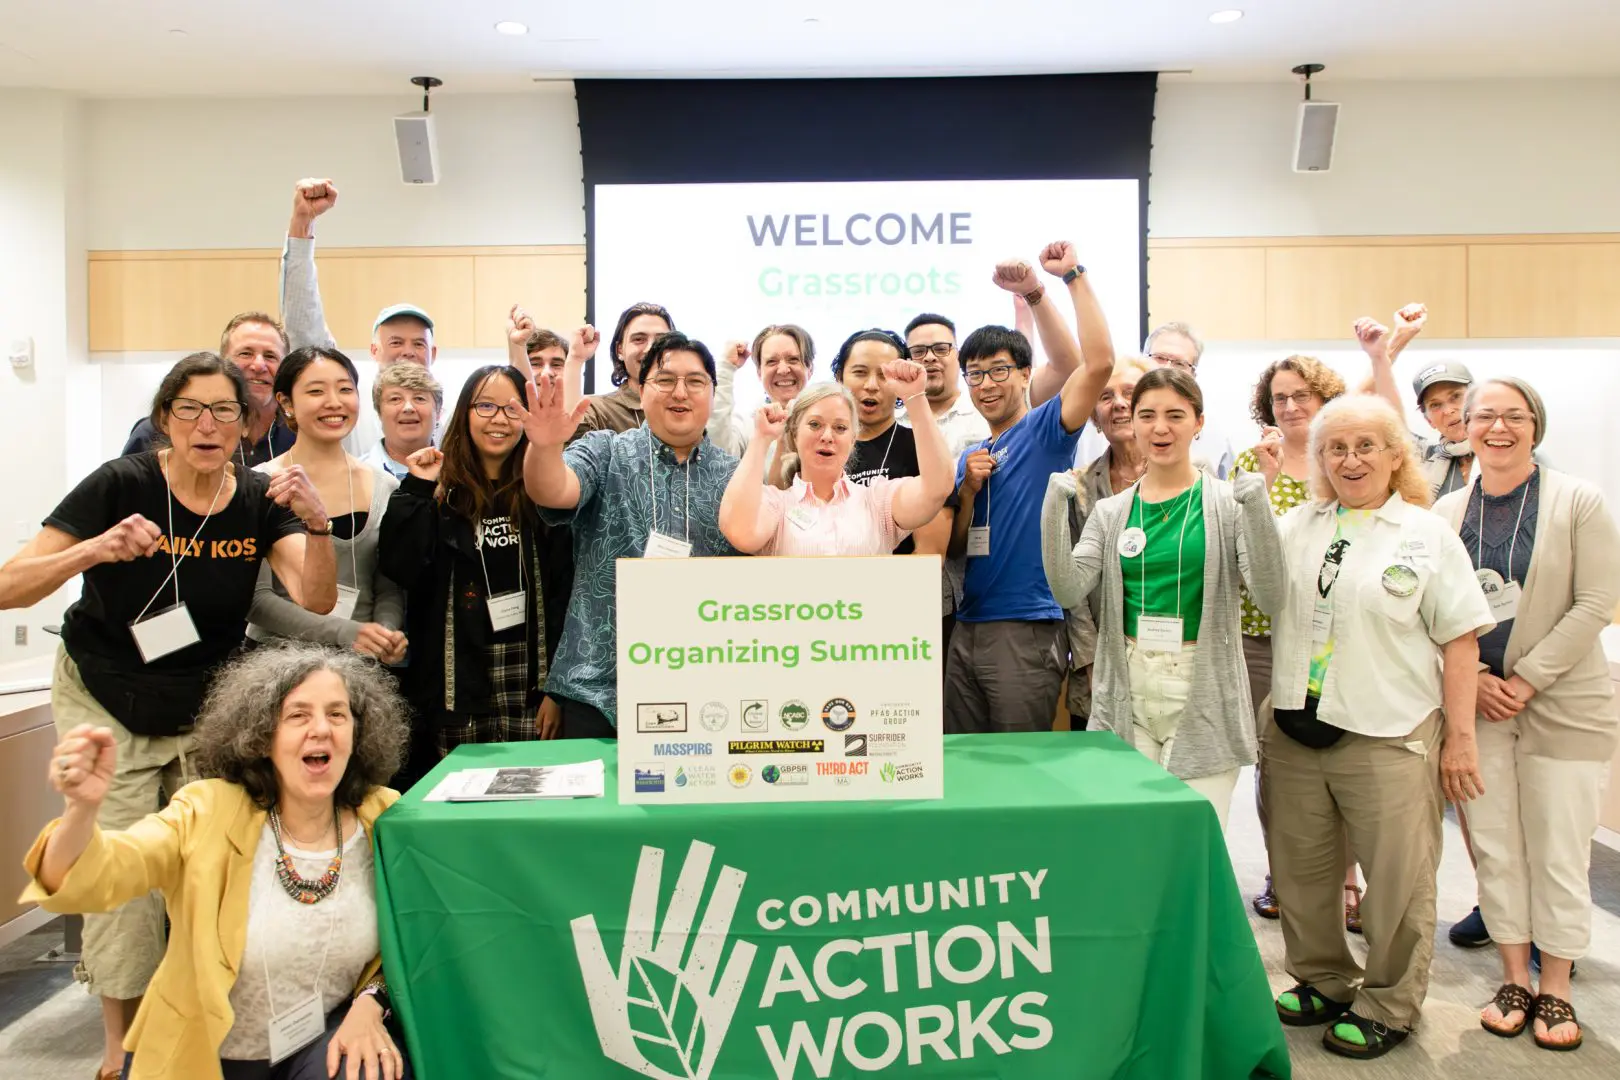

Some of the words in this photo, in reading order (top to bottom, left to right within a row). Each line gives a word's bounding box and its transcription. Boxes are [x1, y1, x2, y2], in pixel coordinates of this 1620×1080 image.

[746, 212, 973, 247] WELCOME
[758, 264, 962, 297] Grassroots
[482, 516, 511, 525] COMMU
[159, 535, 205, 558] AILY
[211, 537, 257, 558] KOS
[698, 599, 863, 622] Grassroots
[628, 639, 800, 670] Organizing
[810, 637, 932, 662] Summit
[870, 709, 890, 717] PFAS
[894, 709, 920, 717] ACTION
[883, 717, 907, 725] GROUP
[868, 733, 906, 742] SURFRIDER
[653, 743, 713, 756] MASSPIRG
[730, 741, 773, 750] PILGRIM
[775, 740, 810, 749] WATCH
[780, 765, 807, 773] GBPSR
[848, 761, 869, 775] ACT
[896, 766, 923, 776] ACTION
[896, 773, 924, 782] WORKS
[756, 869, 1049, 930] COMMUNITY
[758, 915, 1053, 1008] ACTION
[755, 991, 1054, 1080] WORKS
